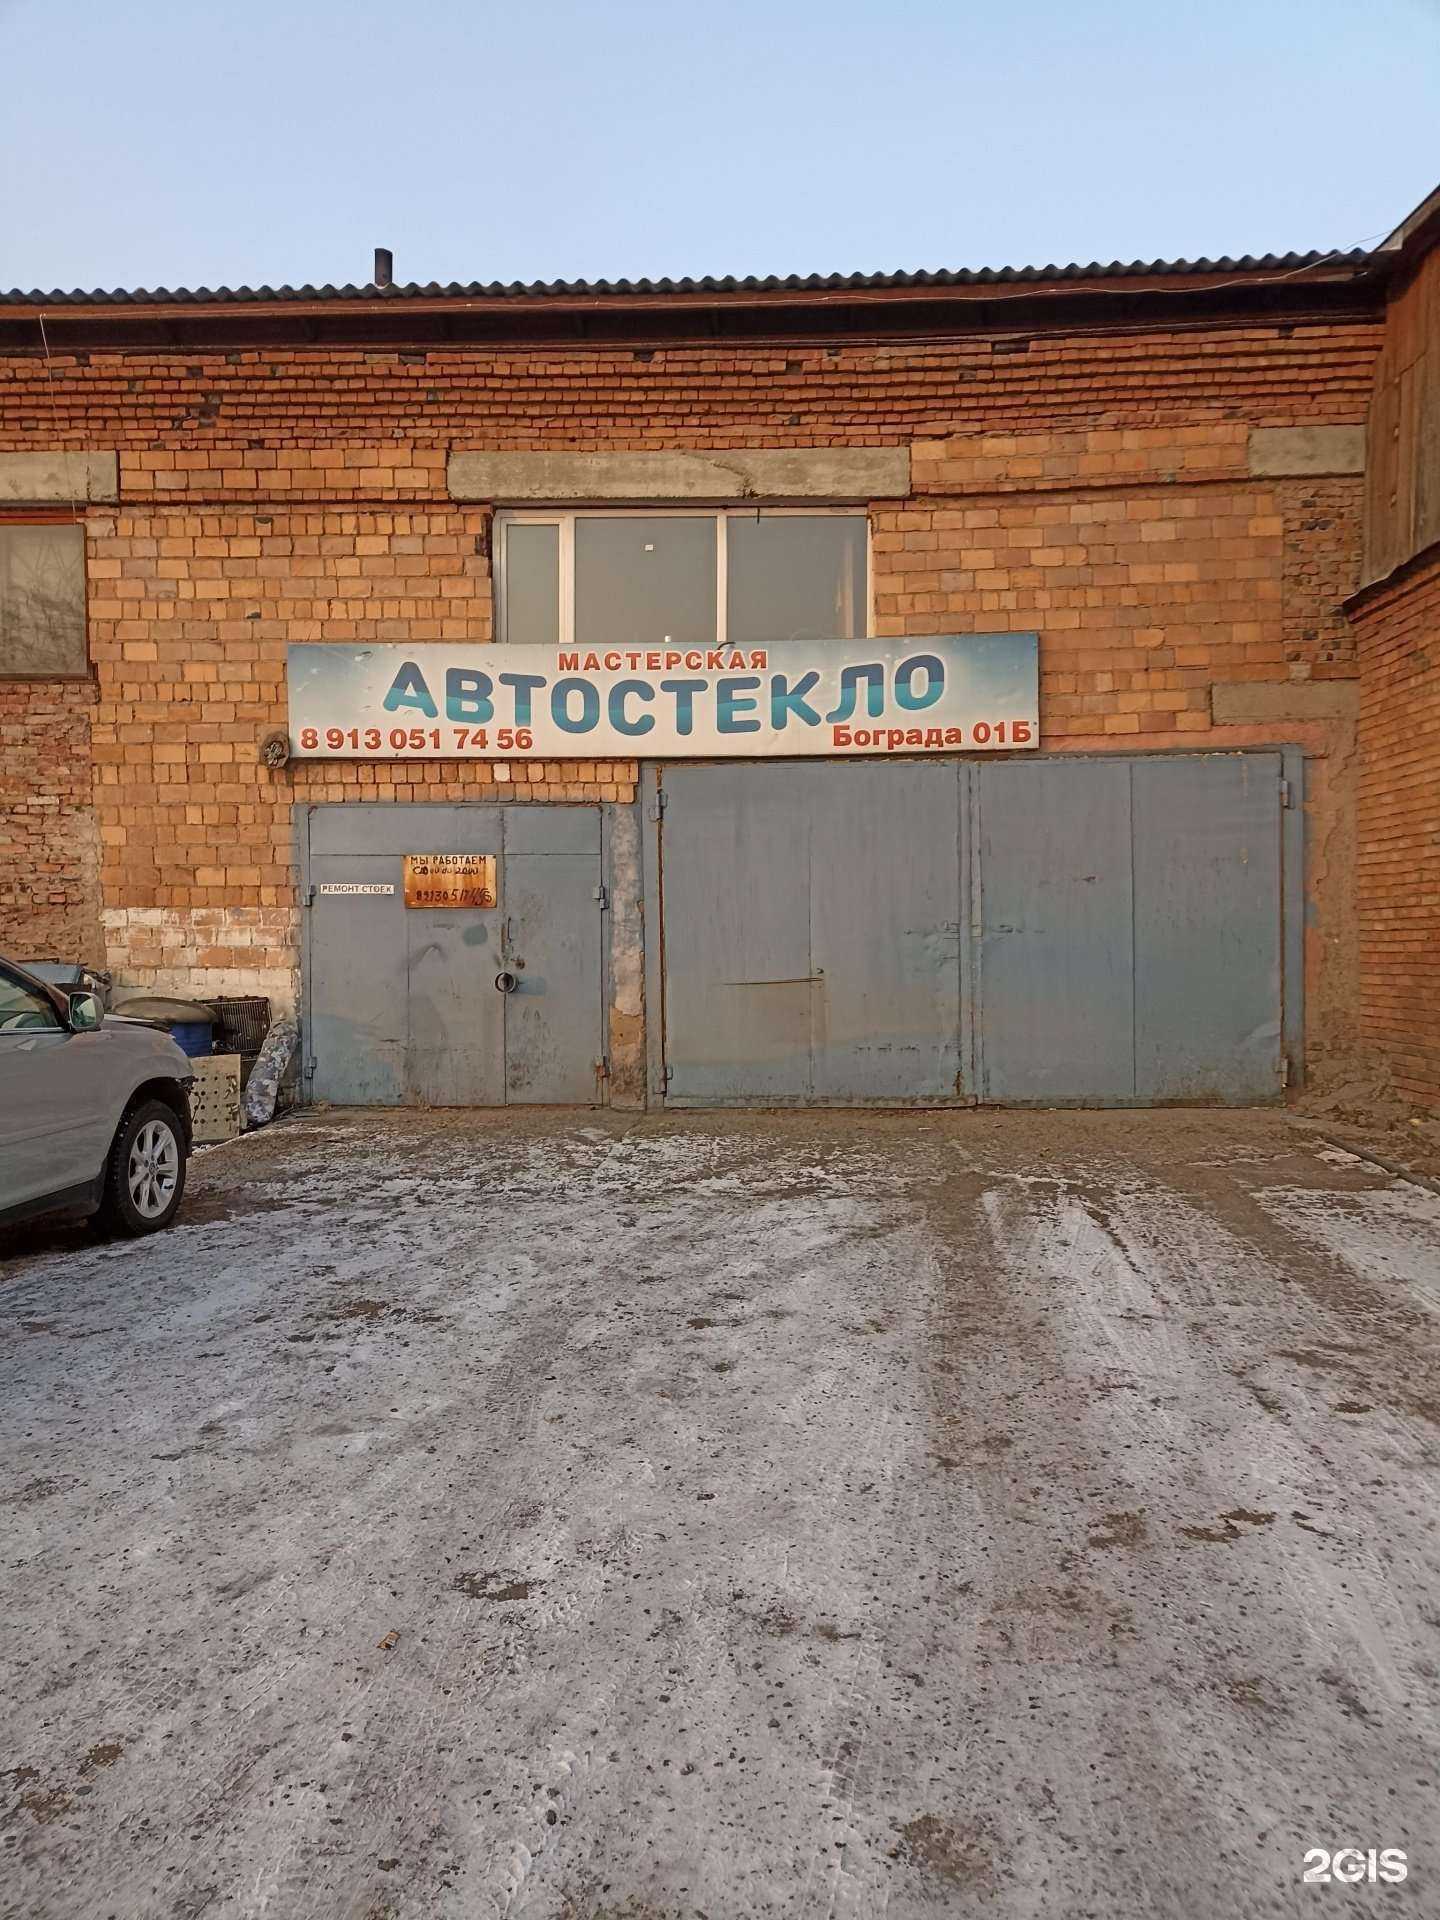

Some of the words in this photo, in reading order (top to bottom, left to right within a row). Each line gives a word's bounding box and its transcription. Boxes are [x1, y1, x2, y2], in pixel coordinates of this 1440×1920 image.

[558, 650, 767, 671] МАСТЕРСКАЯ
[382, 654, 945, 736] АВТОСТЕКЛО
[301, 728, 318, 749] 8
[327, 728, 382, 749] 913
[389, 728, 441, 749] 051
[453, 728, 489, 749] 74
[496, 728, 533, 749] 56
[833, 724, 962, 749] Бограда
[973, 721, 1032, 743] 01Б
[411, 856, 428, 865] МЫ
[433, 856, 486, 865] РАБОТАЕМ
[322, 885, 359, 893] РЕМОНТ
[361, 885, 392, 893] СТОЕК
